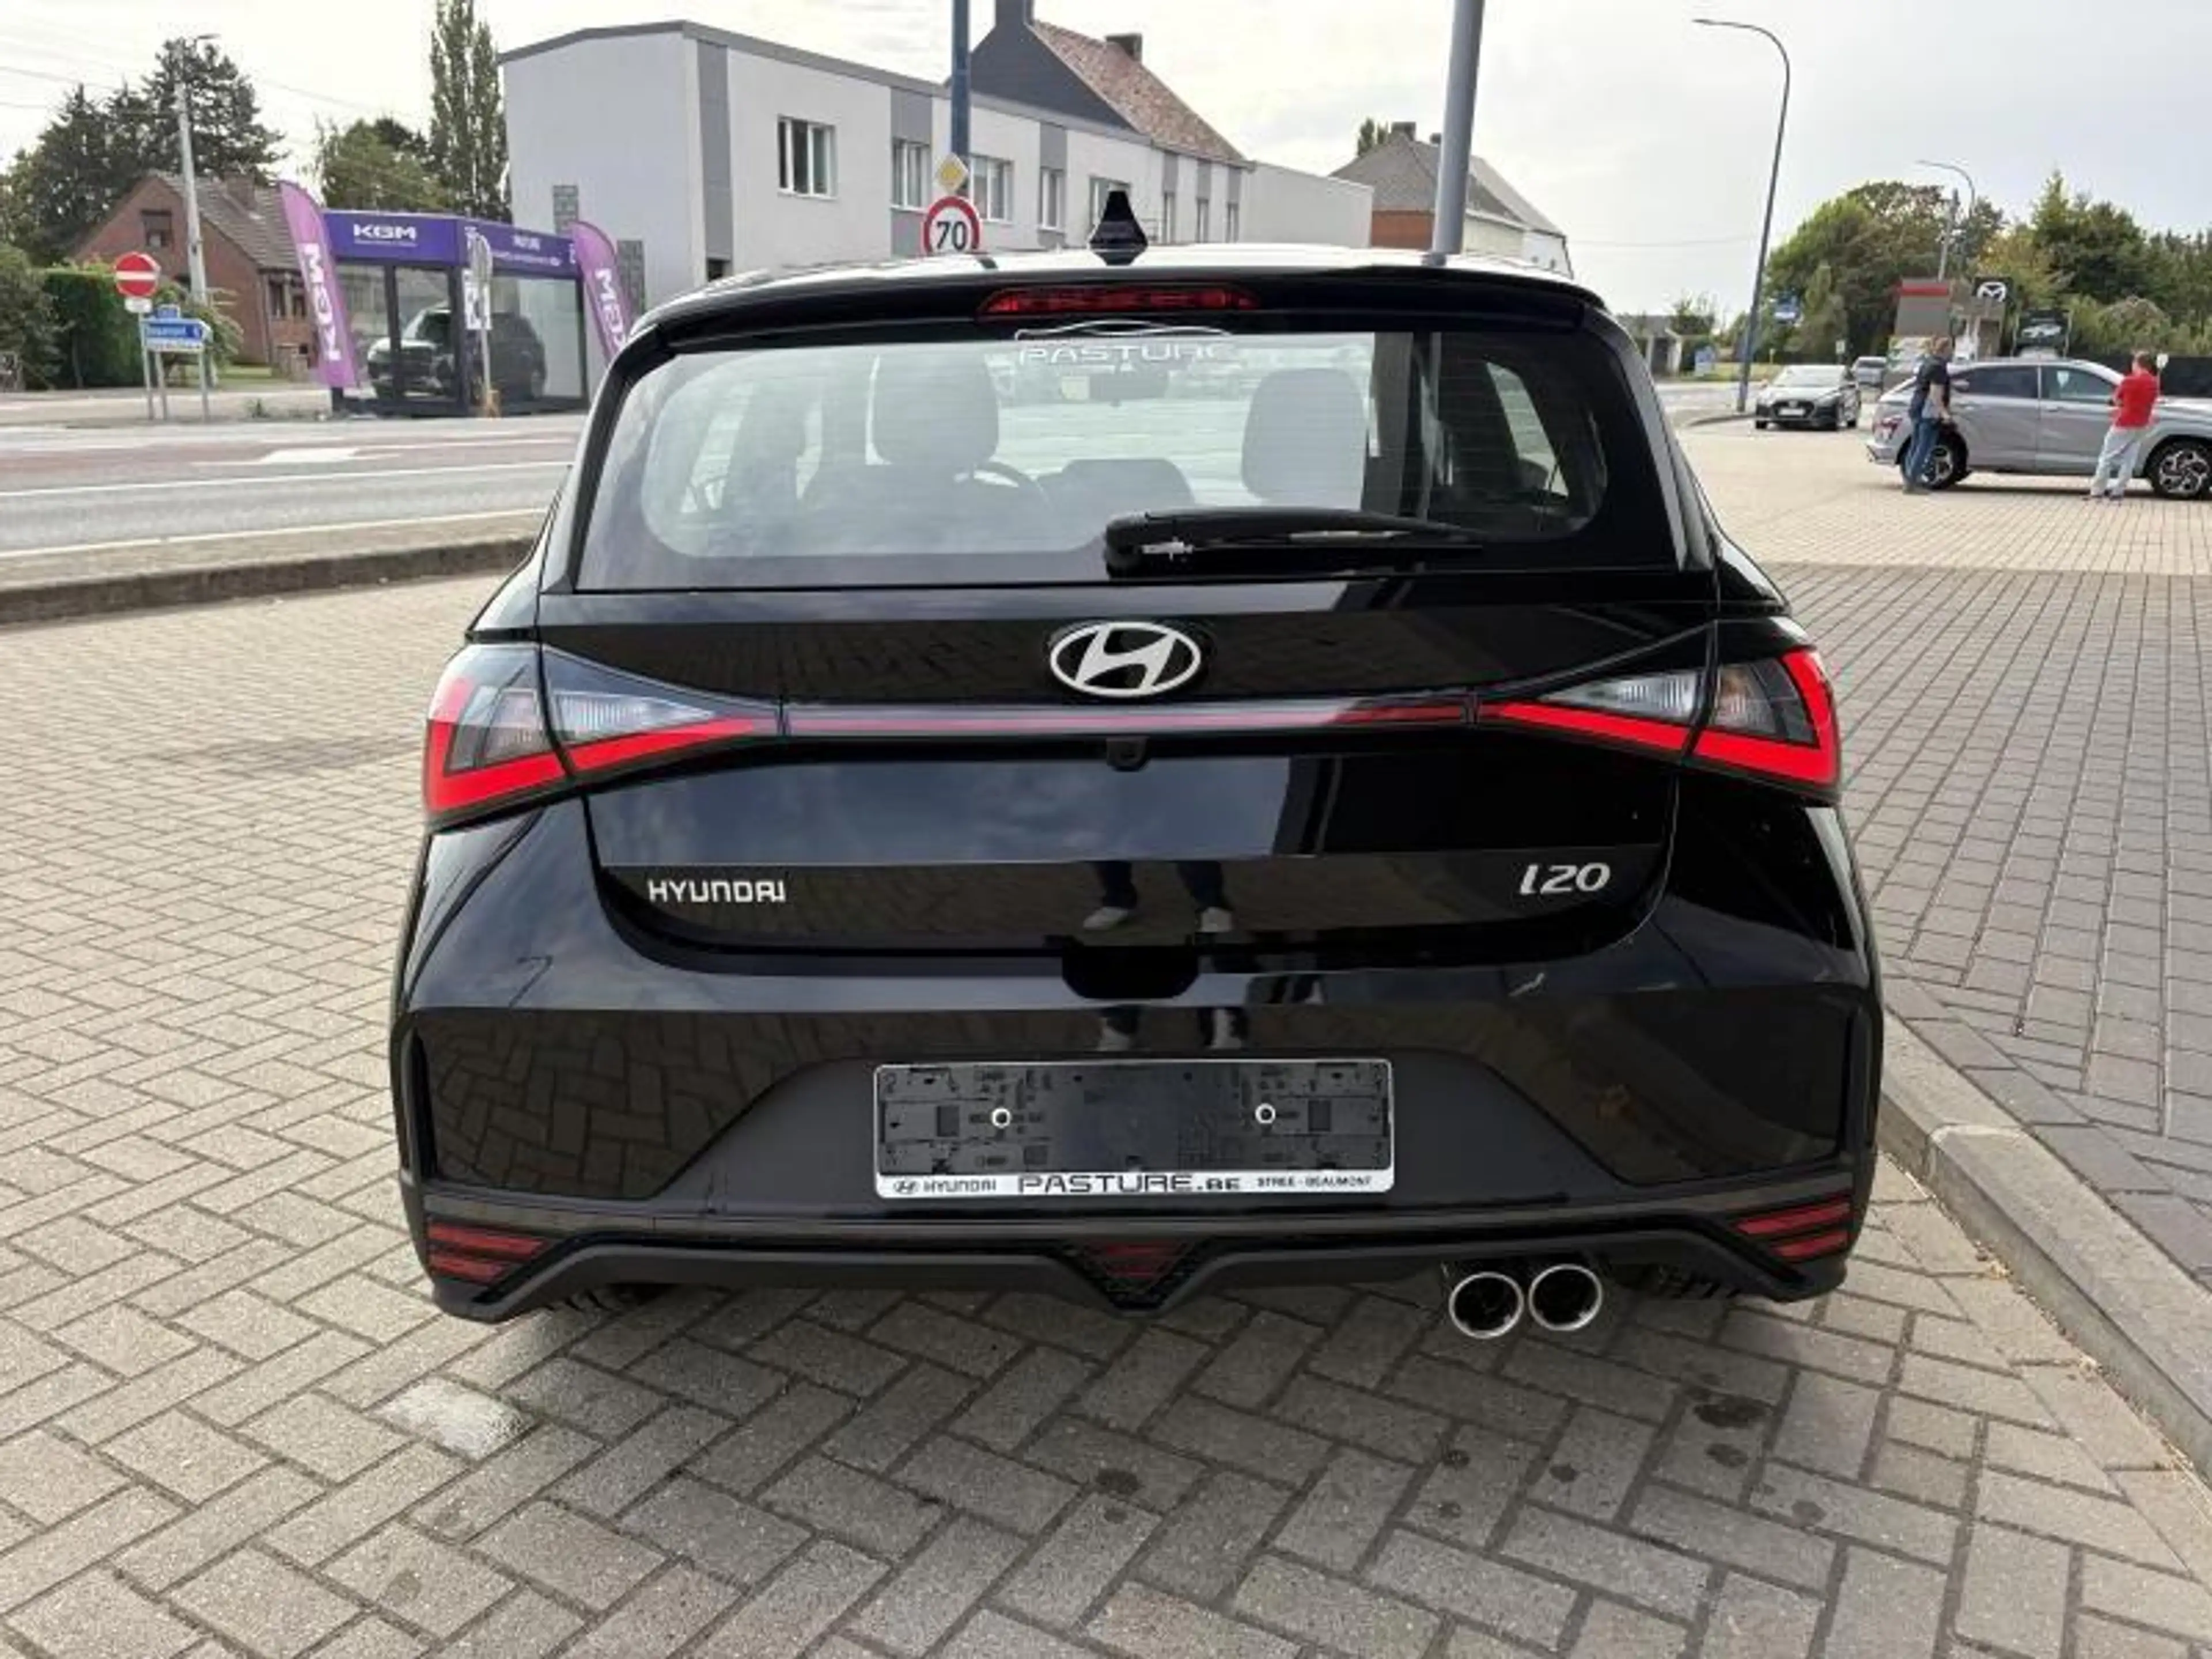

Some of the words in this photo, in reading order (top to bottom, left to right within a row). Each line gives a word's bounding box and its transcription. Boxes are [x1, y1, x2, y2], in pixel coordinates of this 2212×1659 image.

[353, 224, 416, 239] KGM
[937, 221, 967, 251] 70
[647, 879, 786, 903] HYUNDAI
[923, 1179, 997, 1192] HYUNDAI
[1305, 1175, 1372, 1187] BEAUMONT
